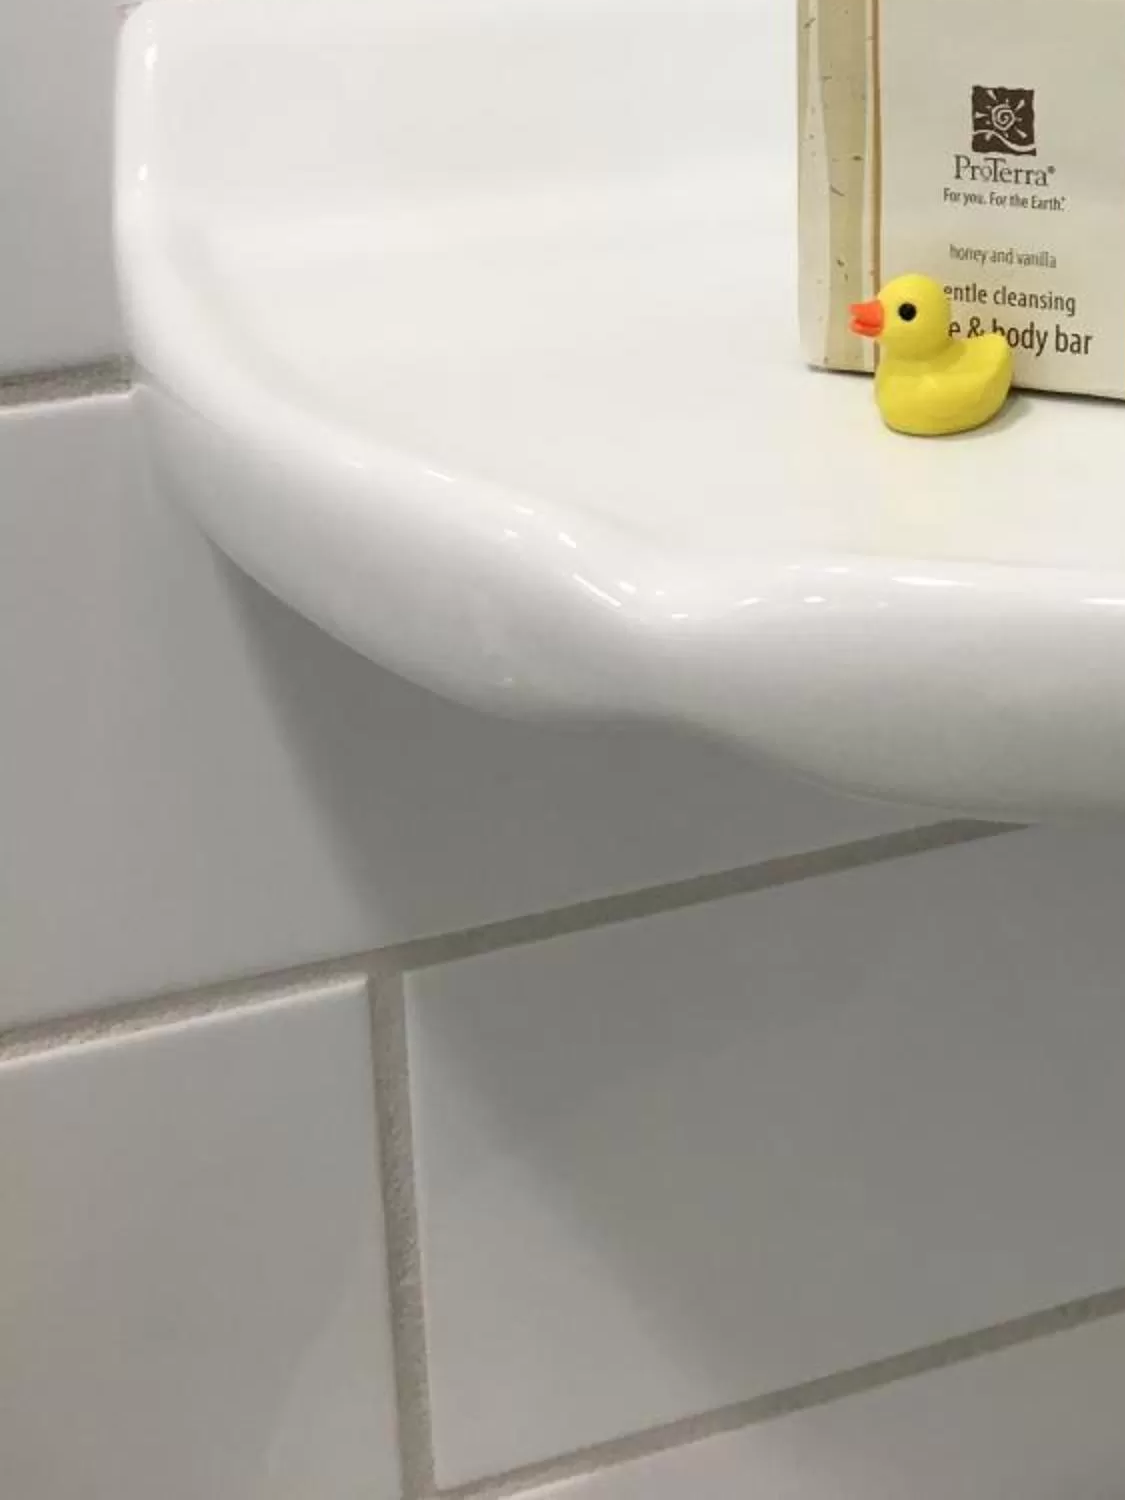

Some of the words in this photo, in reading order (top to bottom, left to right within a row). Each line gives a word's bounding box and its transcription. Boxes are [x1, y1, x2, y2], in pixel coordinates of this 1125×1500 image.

[943, 187, 961, 203] For
[989, 191, 1007, 206] For
[1009, 193, 1029, 209] the
[949, 243, 987, 268] honey
[989, 247, 1014, 265] and
[1016, 250, 1057, 269] vanilla
[943, 283, 988, 305] entle
[993, 285, 1077, 318] cleansing
[1055, 324, 1094, 356] bar
